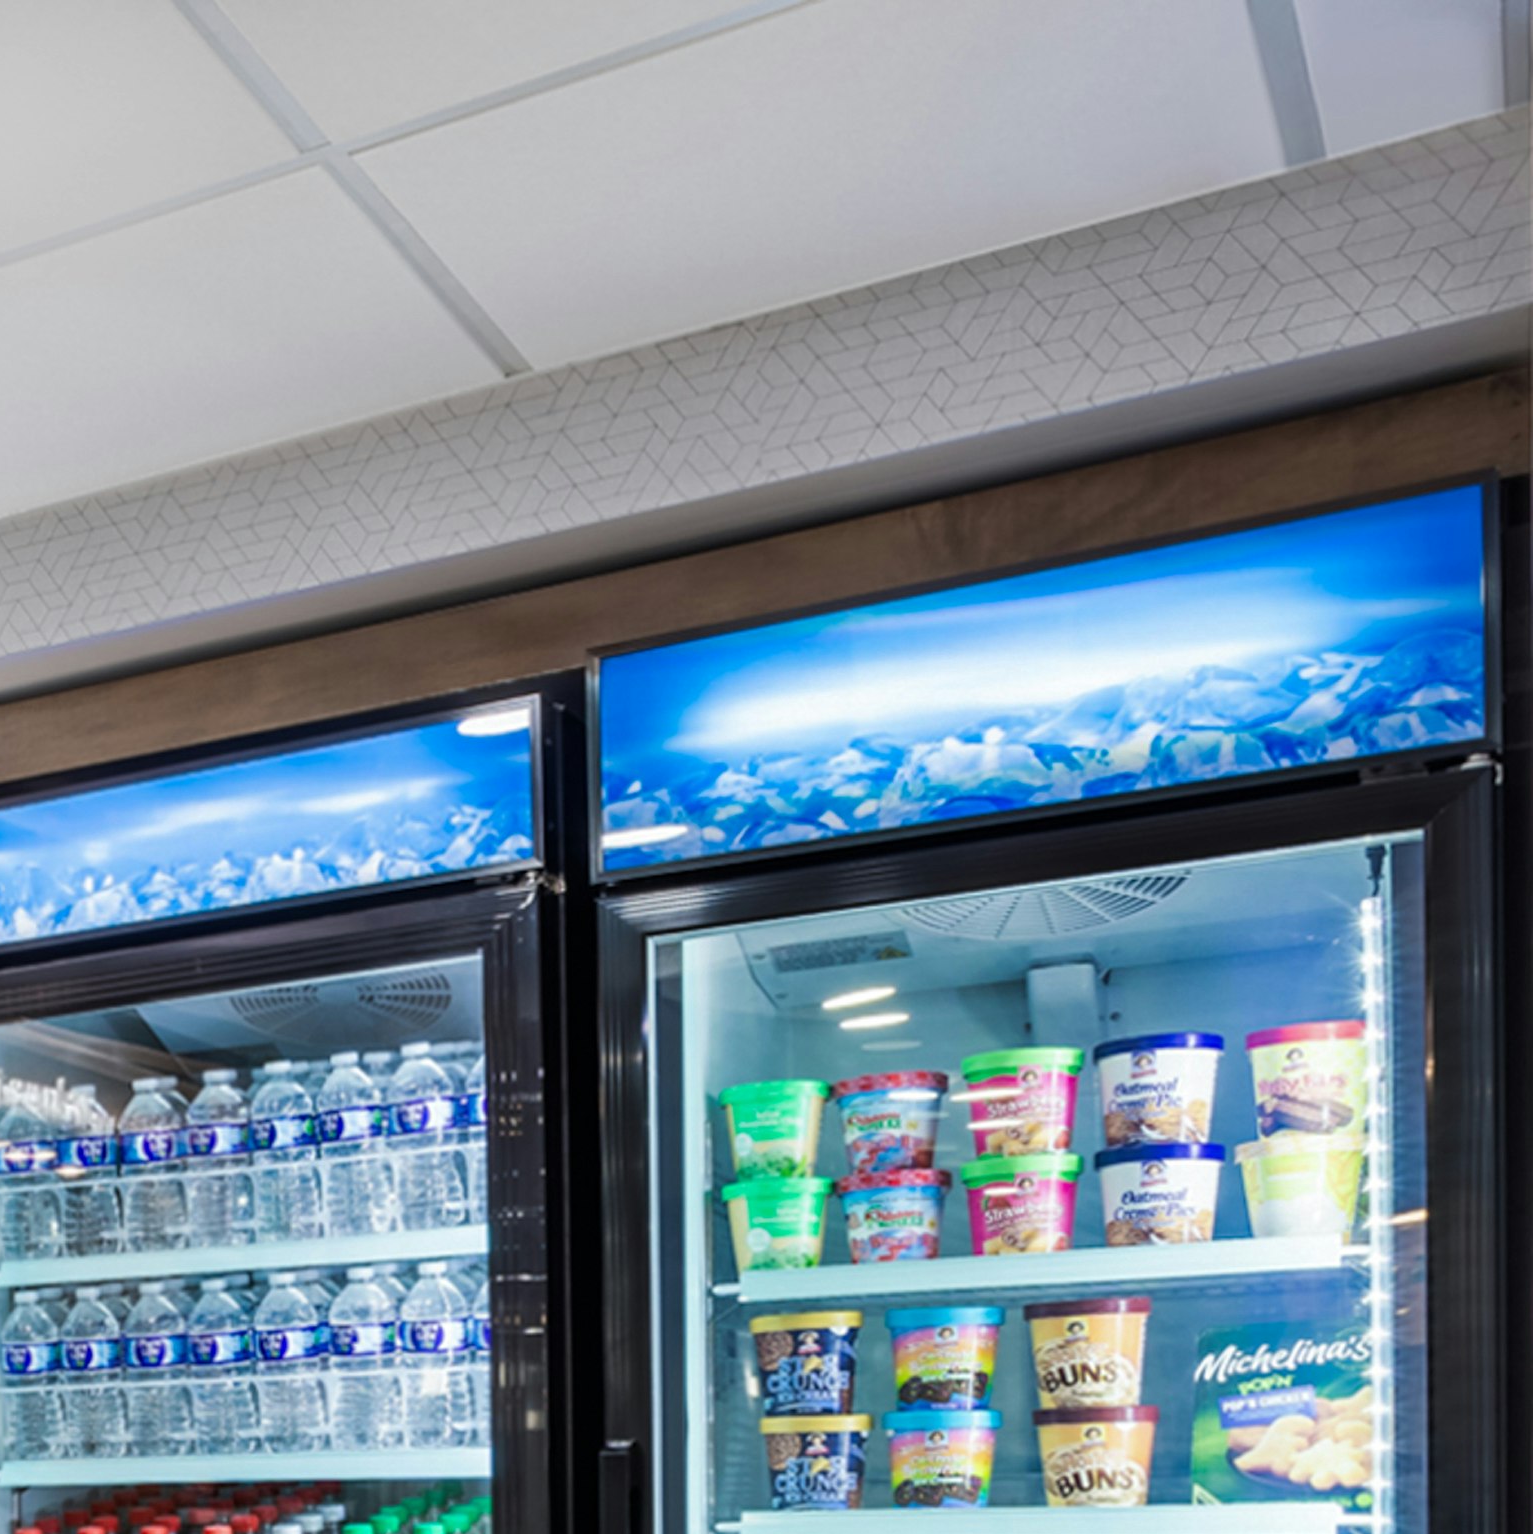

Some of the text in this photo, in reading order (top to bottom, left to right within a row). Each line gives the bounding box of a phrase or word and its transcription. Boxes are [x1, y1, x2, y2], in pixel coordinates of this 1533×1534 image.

[1194, 1333, 1373, 1385] Michelina's
[1043, 1361, 1117, 1393] BUNS
[1256, 1392, 1312, 1410] CHICKEN
[1057, 1469, 1134, 1498] BUNS
